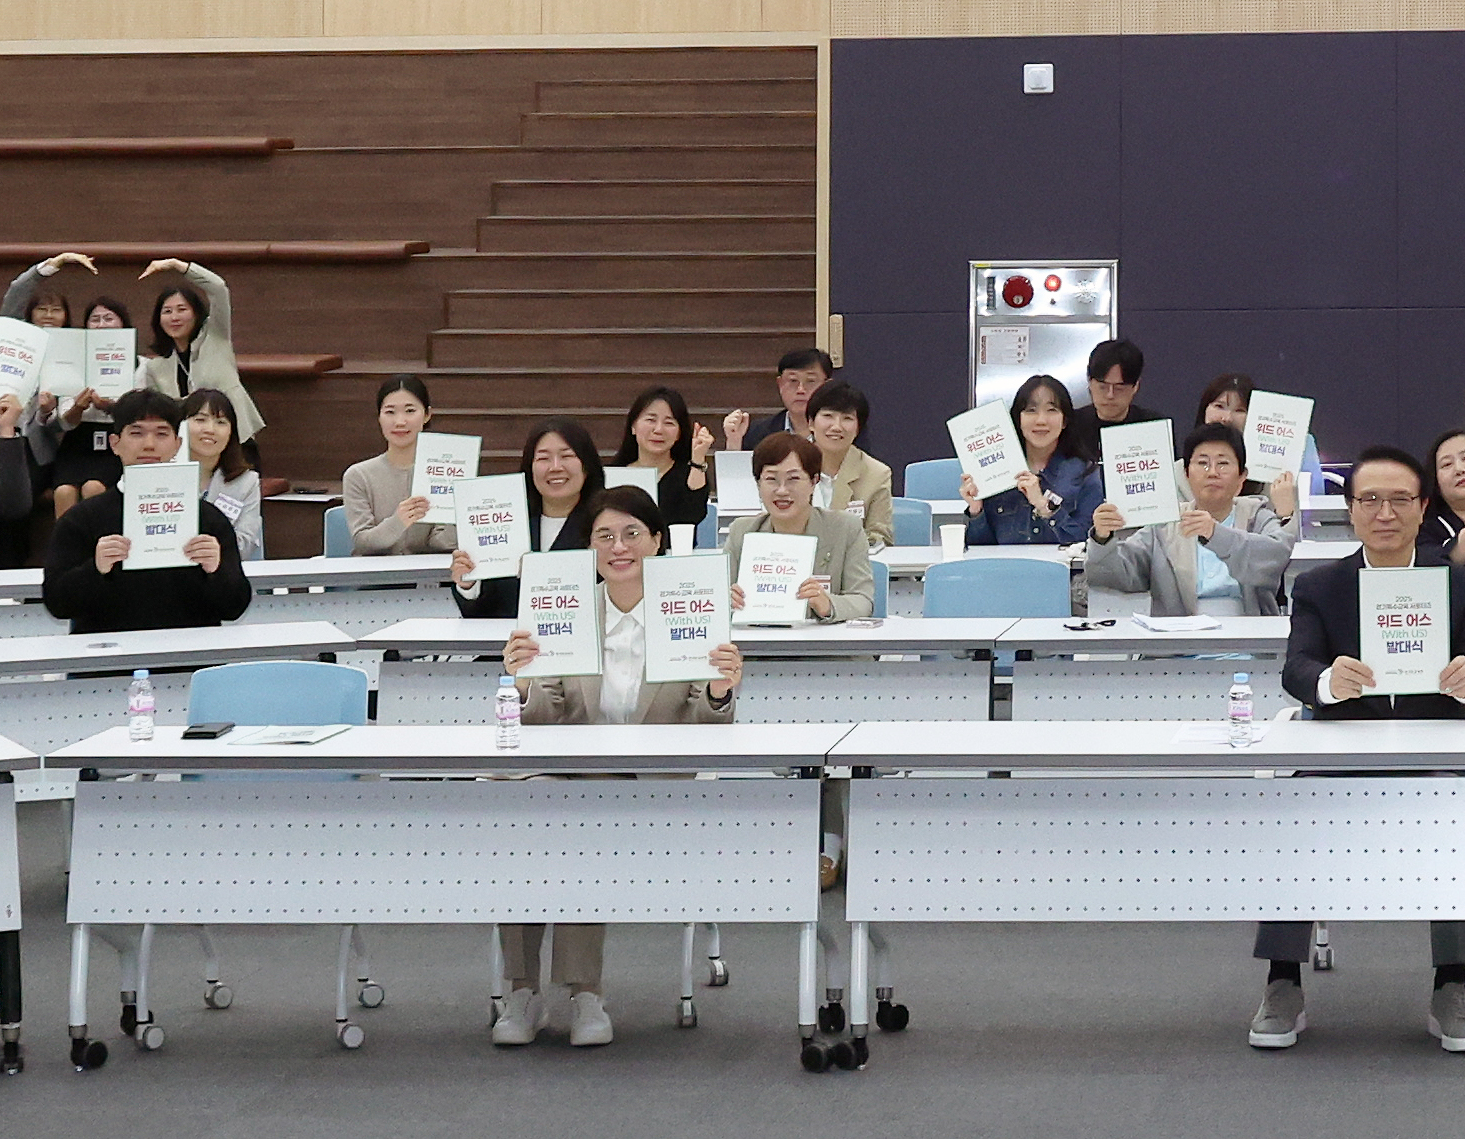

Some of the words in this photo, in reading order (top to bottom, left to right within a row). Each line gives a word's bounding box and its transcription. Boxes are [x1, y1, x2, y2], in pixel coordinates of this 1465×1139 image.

[1116, 461, 1137, 475] 위드
[1138, 459, 1160, 471] 어스
[1124, 480, 1156, 496] 발대식
[468, 513, 491, 526] 위드
[492, 511, 514, 524] 어스
[477, 533, 509, 547] 발대식
[530, 596, 553, 610] 위드
[555, 595, 580, 609] 어스
[660, 600, 687, 615] 위드
[689, 599, 715, 614] 어스
[1377, 614, 1403, 628] 위드
[1405, 613, 1432, 627] 어스
[537, 621, 573, 636] 발대식
[670, 625, 707, 641] 발대식
[1386, 639, 1424, 654] 발대식
